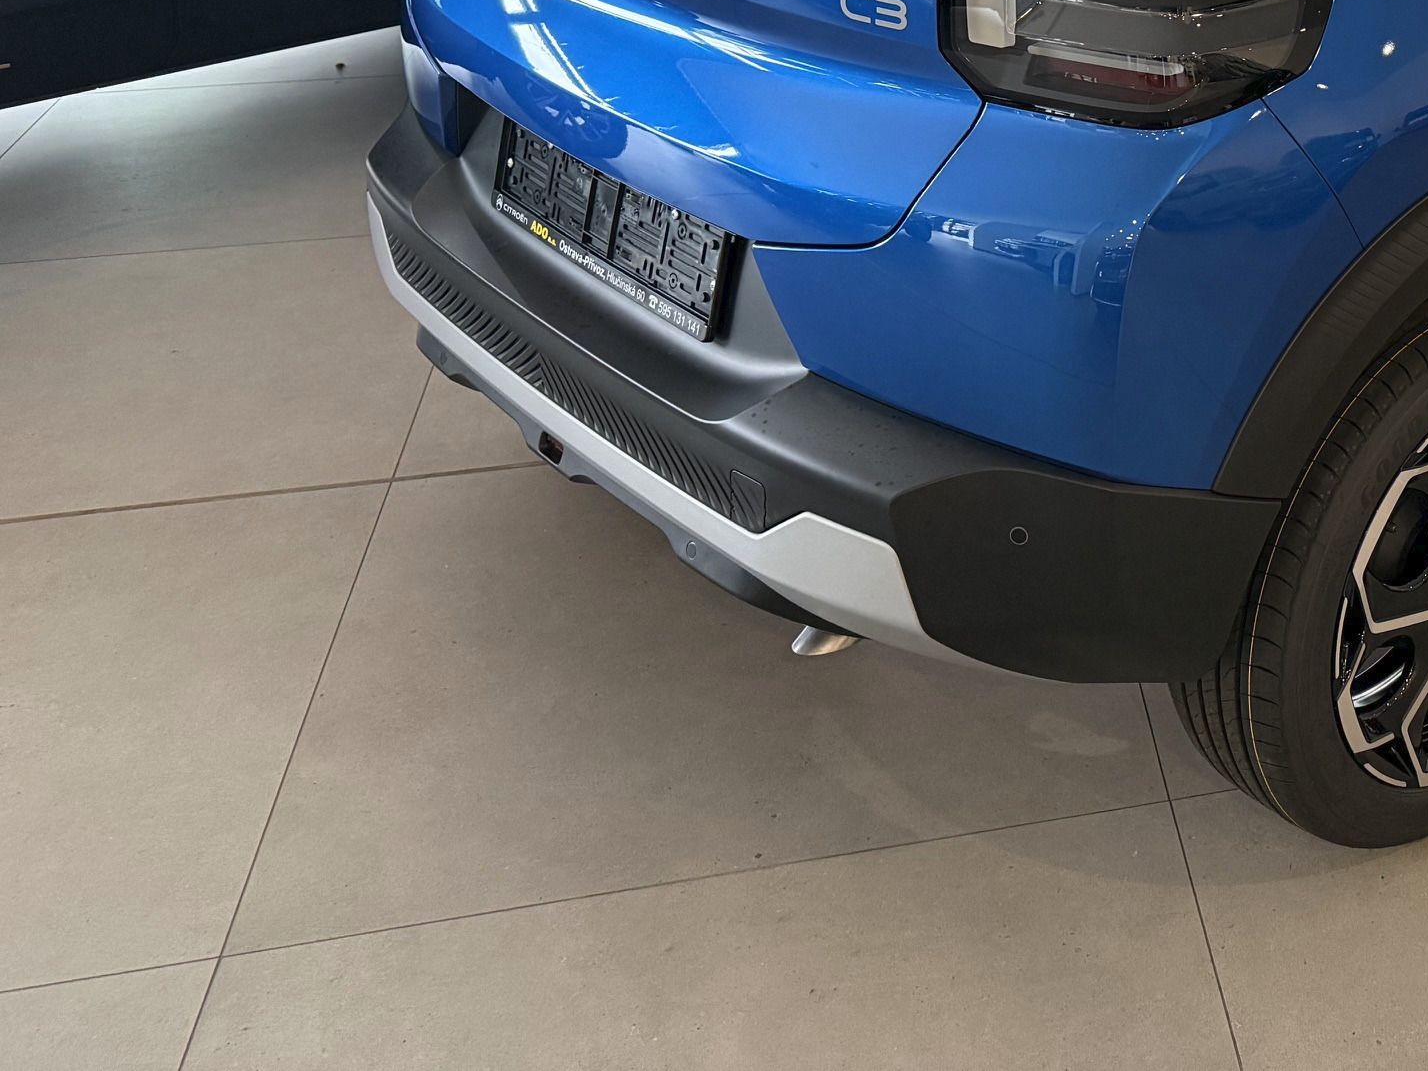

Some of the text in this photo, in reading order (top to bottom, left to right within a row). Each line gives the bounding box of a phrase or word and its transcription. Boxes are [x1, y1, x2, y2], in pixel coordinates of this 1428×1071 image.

[503, 203, 528, 225] CITROËN
[530, 220, 549, 240] ADO
[606, 270, 636, 297] Hlučínská
[636, 288, 646, 303] 60
[657, 302, 672, 319] 595
[673, 310, 686, 327] 131
[688, 320, 701, 336] 141
